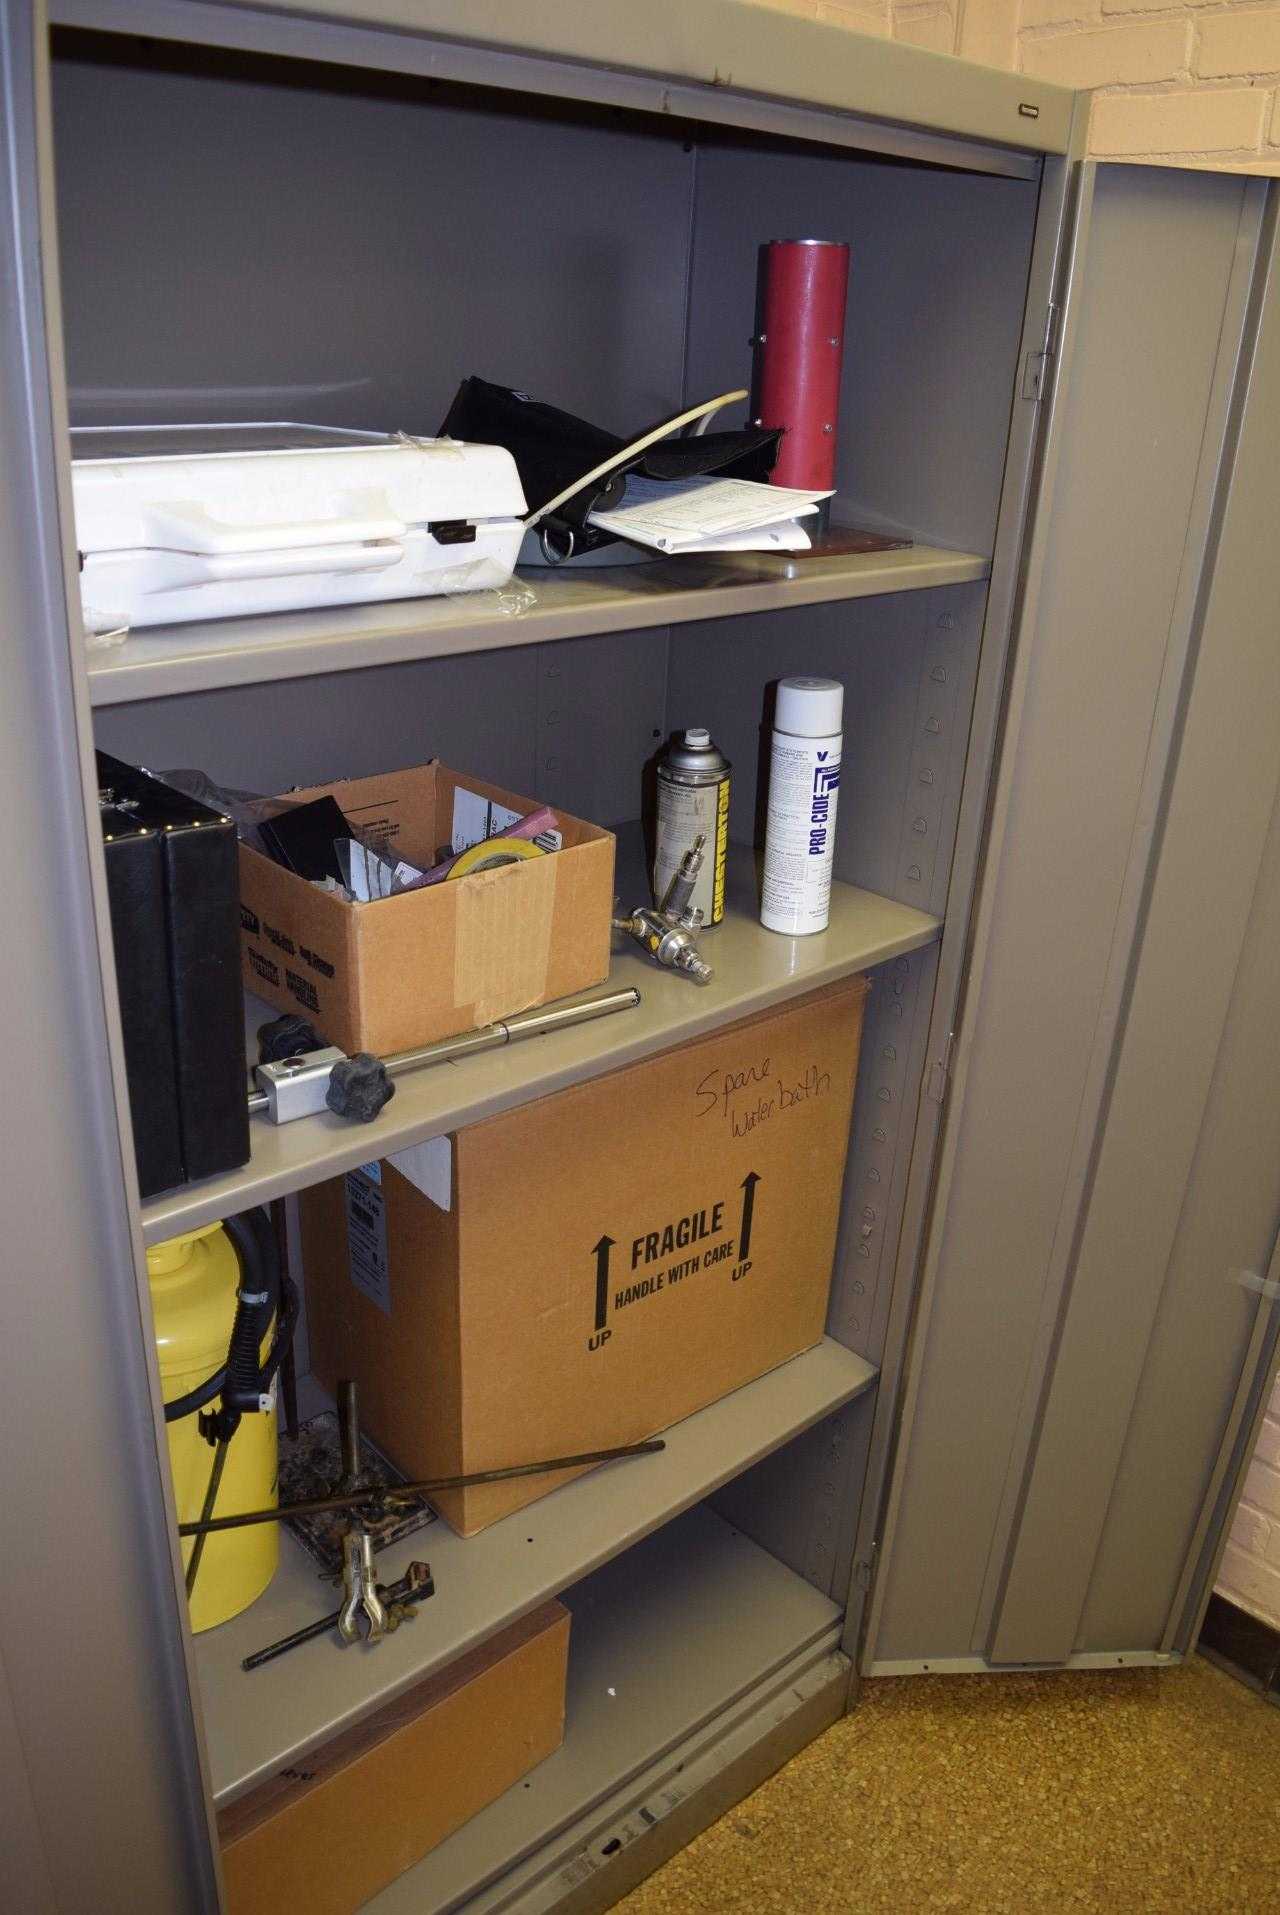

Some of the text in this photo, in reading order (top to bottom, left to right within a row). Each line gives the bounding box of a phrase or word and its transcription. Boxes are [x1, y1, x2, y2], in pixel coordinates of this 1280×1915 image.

[809, 793, 830, 856] PRO-CIDE
[696, 1057, 772, 1118] Spare
[631, 1201, 725, 1270] FRAGILE
[614, 1239, 735, 1310] HANDLE WITH CARE
[731, 1261, 753, 1282] UP
[588, 1330, 613, 1352] UP
